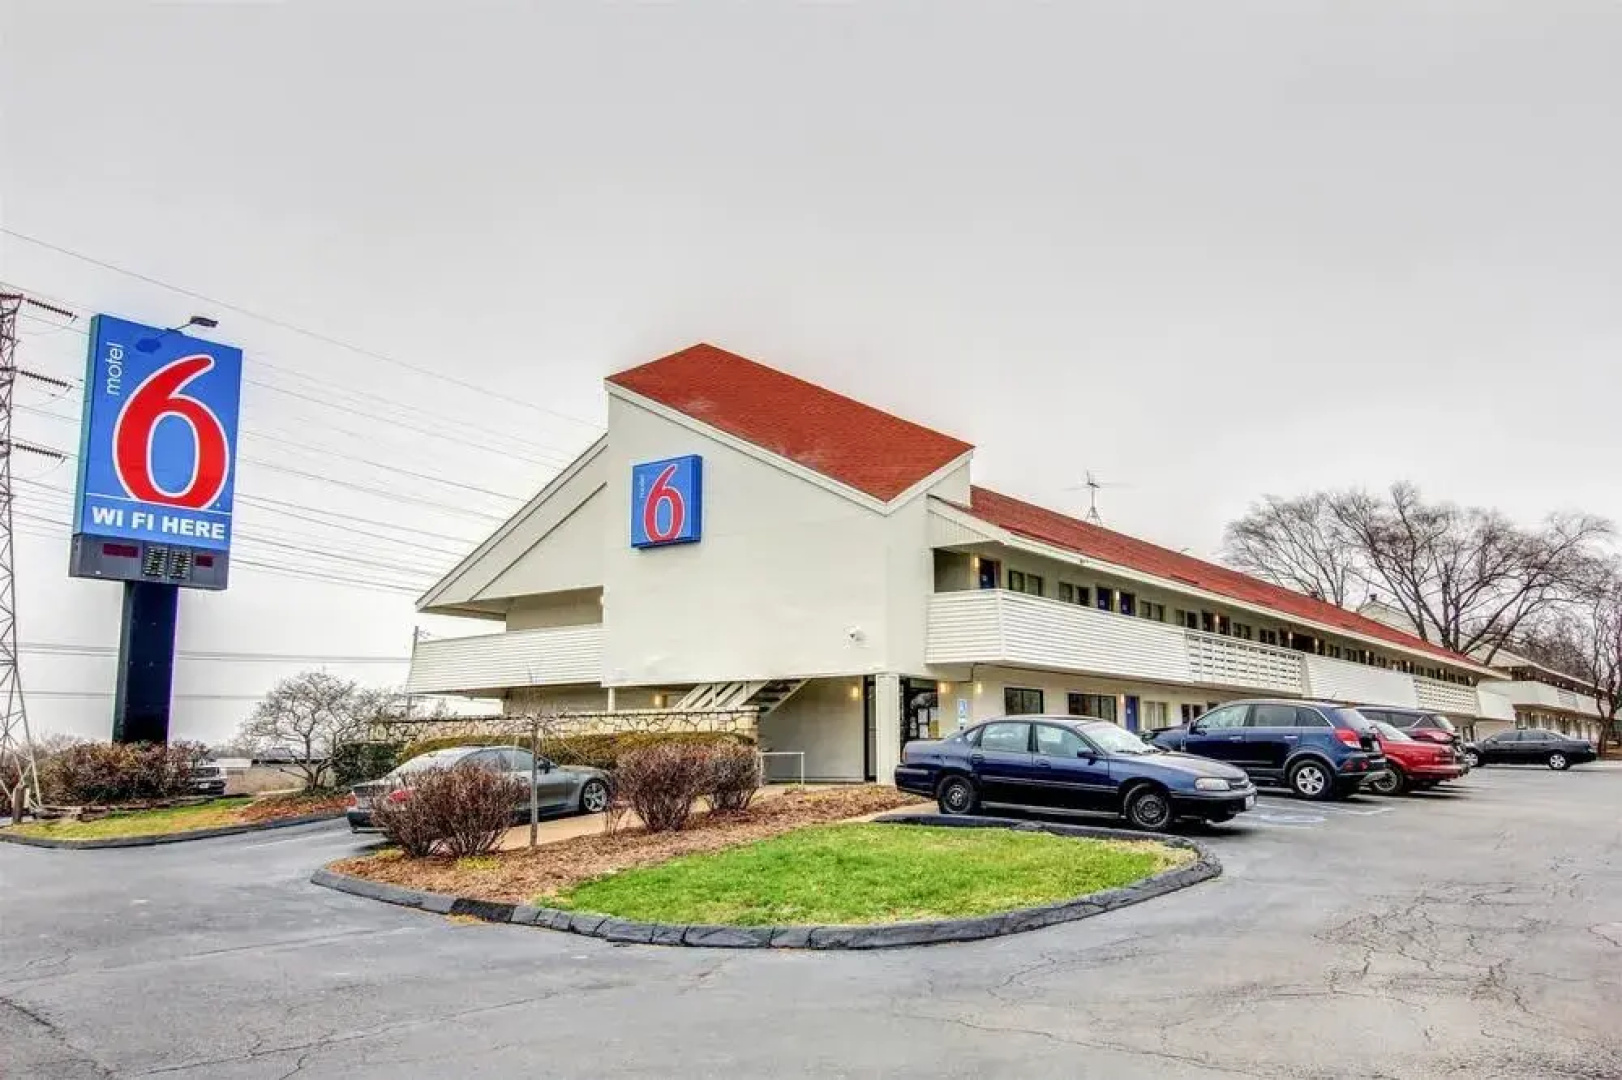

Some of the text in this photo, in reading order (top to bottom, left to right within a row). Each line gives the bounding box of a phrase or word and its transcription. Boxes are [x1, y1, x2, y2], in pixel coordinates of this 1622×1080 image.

[106, 342, 123, 396] motel
[113, 354, 229, 510] 6
[92, 506, 225, 540] WI FI HERE
[644, 463, 685, 543] 6
